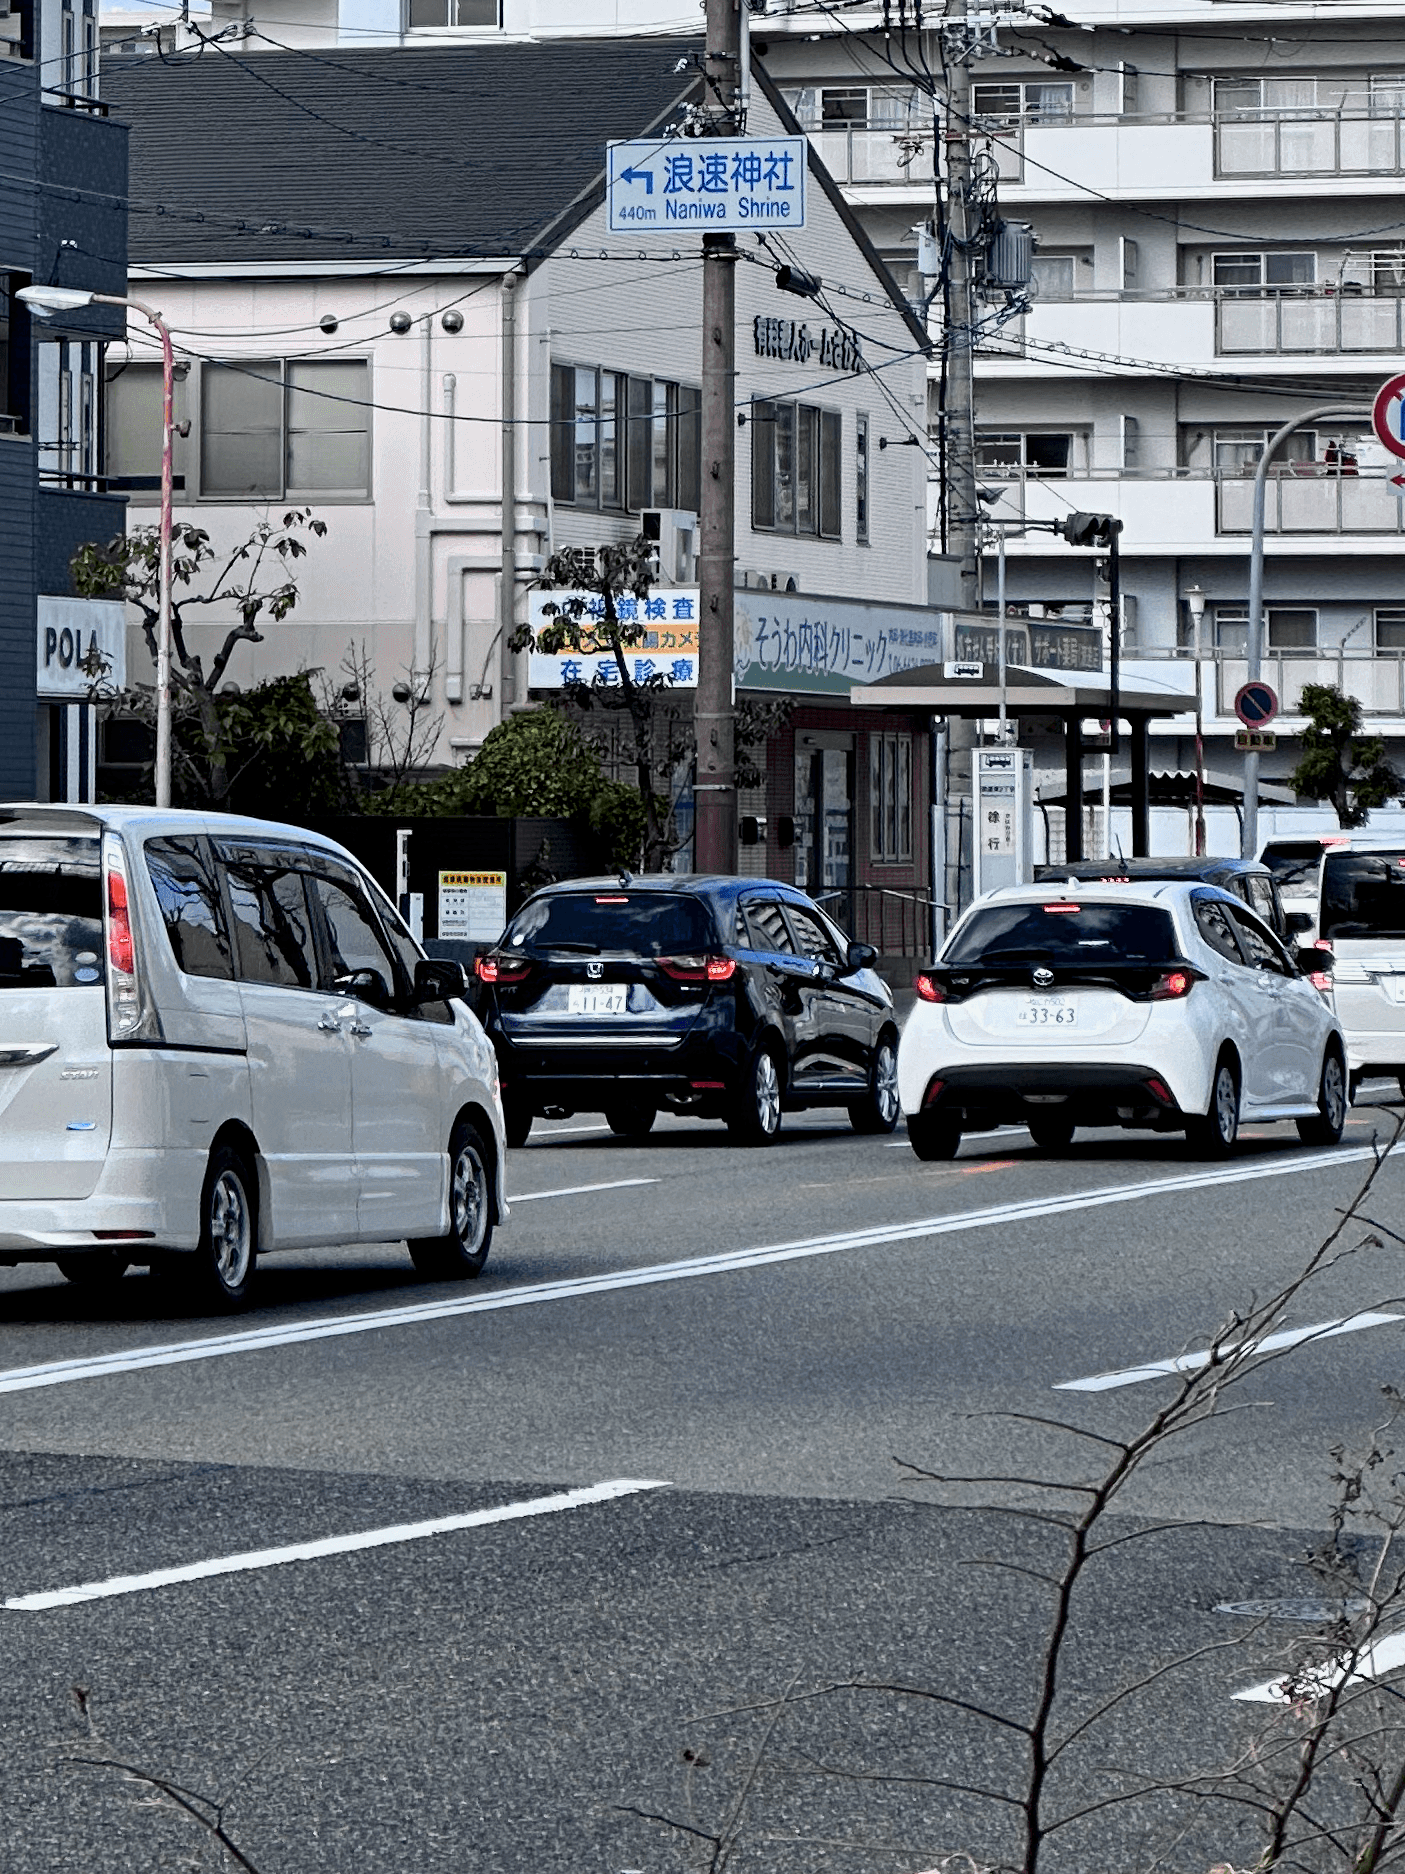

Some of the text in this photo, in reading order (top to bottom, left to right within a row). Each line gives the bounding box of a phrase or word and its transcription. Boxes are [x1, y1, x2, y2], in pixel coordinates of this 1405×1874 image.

[663, 151, 794, 194] 浪速神社
[619, 196, 790, 220] 440m Naniwa Shrine
[755, 617, 887, 673] そうわ内科クリニック
[1029, 1007, 1074, 1024] 33-63
